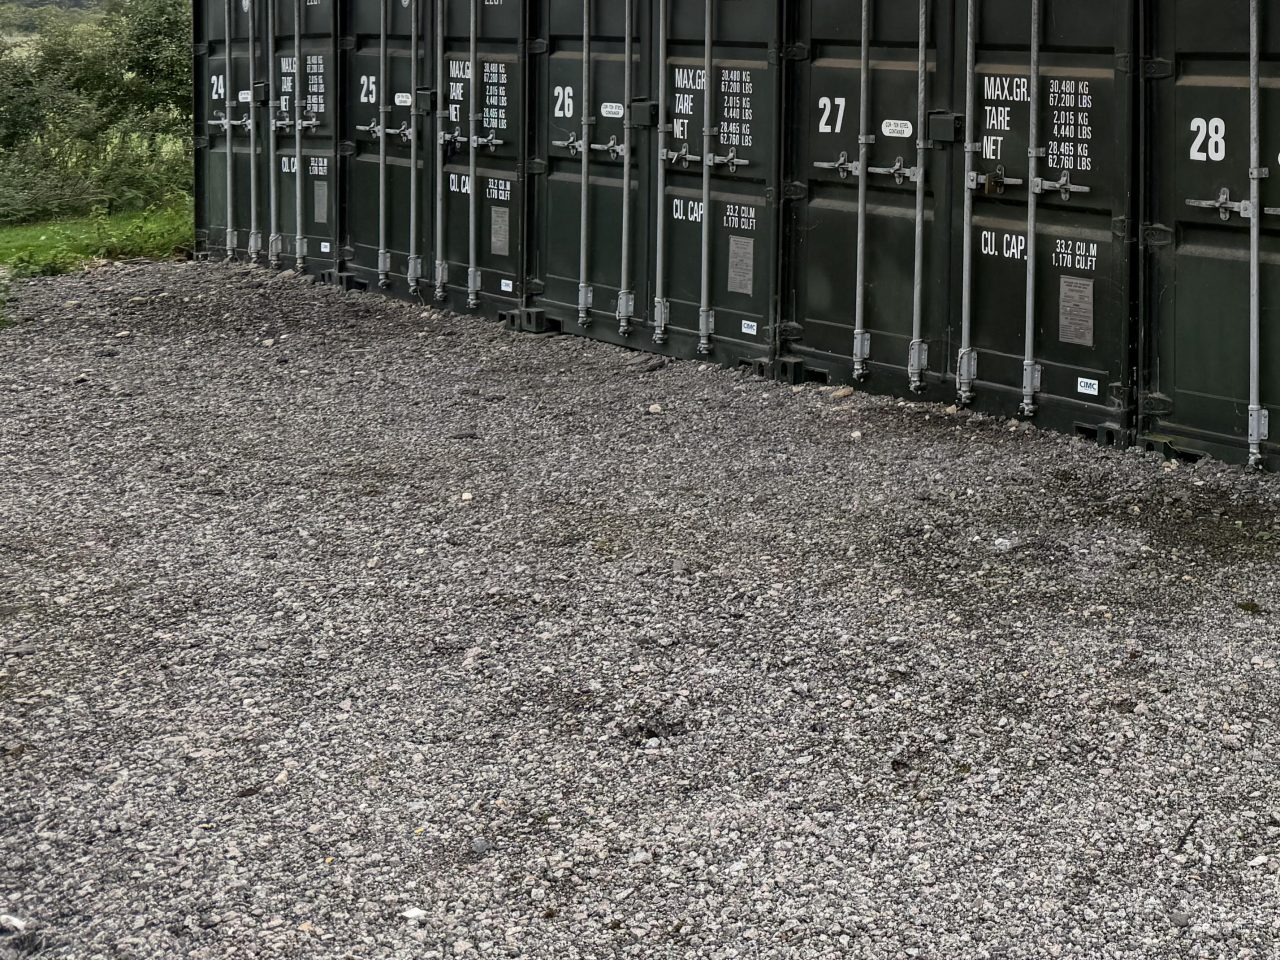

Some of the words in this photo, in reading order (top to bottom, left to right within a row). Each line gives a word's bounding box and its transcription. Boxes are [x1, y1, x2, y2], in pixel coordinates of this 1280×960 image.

[211, 75, 224, 99] 24
[360, 76, 376, 103] 25
[985, 77, 1030, 101] MAX.GR.
[1050, 80, 1074, 94] 30,480
[1079, 81, 1088, 94] KG
[554, 87, 573, 117] 26
[675, 93, 693, 114] TARE
[1049, 94, 1074, 107] 67,200
[1079, 95, 1092, 108] LBS
[819, 97, 845, 132] 27
[985, 106, 1010, 130] TARE
[1054, 111, 1074, 125] 2,015
[1078, 112, 1088, 125] KG
[674, 119, 688, 139] NET
[1053, 125, 1074, 139] 4,440
[1078, 126, 1091, 139] LBS
[983, 137, 1003, 160] NET
[1049, 142, 1074, 156] 28,465
[1078, 144, 1088, 156] KG
[1190, 118, 1225, 161] 28
[1049, 156, 1073, 170] 62,760
[1077, 158, 1091, 170] LBS
[673, 199, 685, 219] CU.
[982, 231, 998, 256] CU.
[1004, 234, 1027, 260] CAP.
[1056, 240, 1072, 254] 33.2
[1076, 242, 1096, 256] CU.M
[1052, 253, 1071, 268] 1,170
[1075, 256, 1096, 270] CU.FT
[1079, 380, 1096, 391] CIMC
